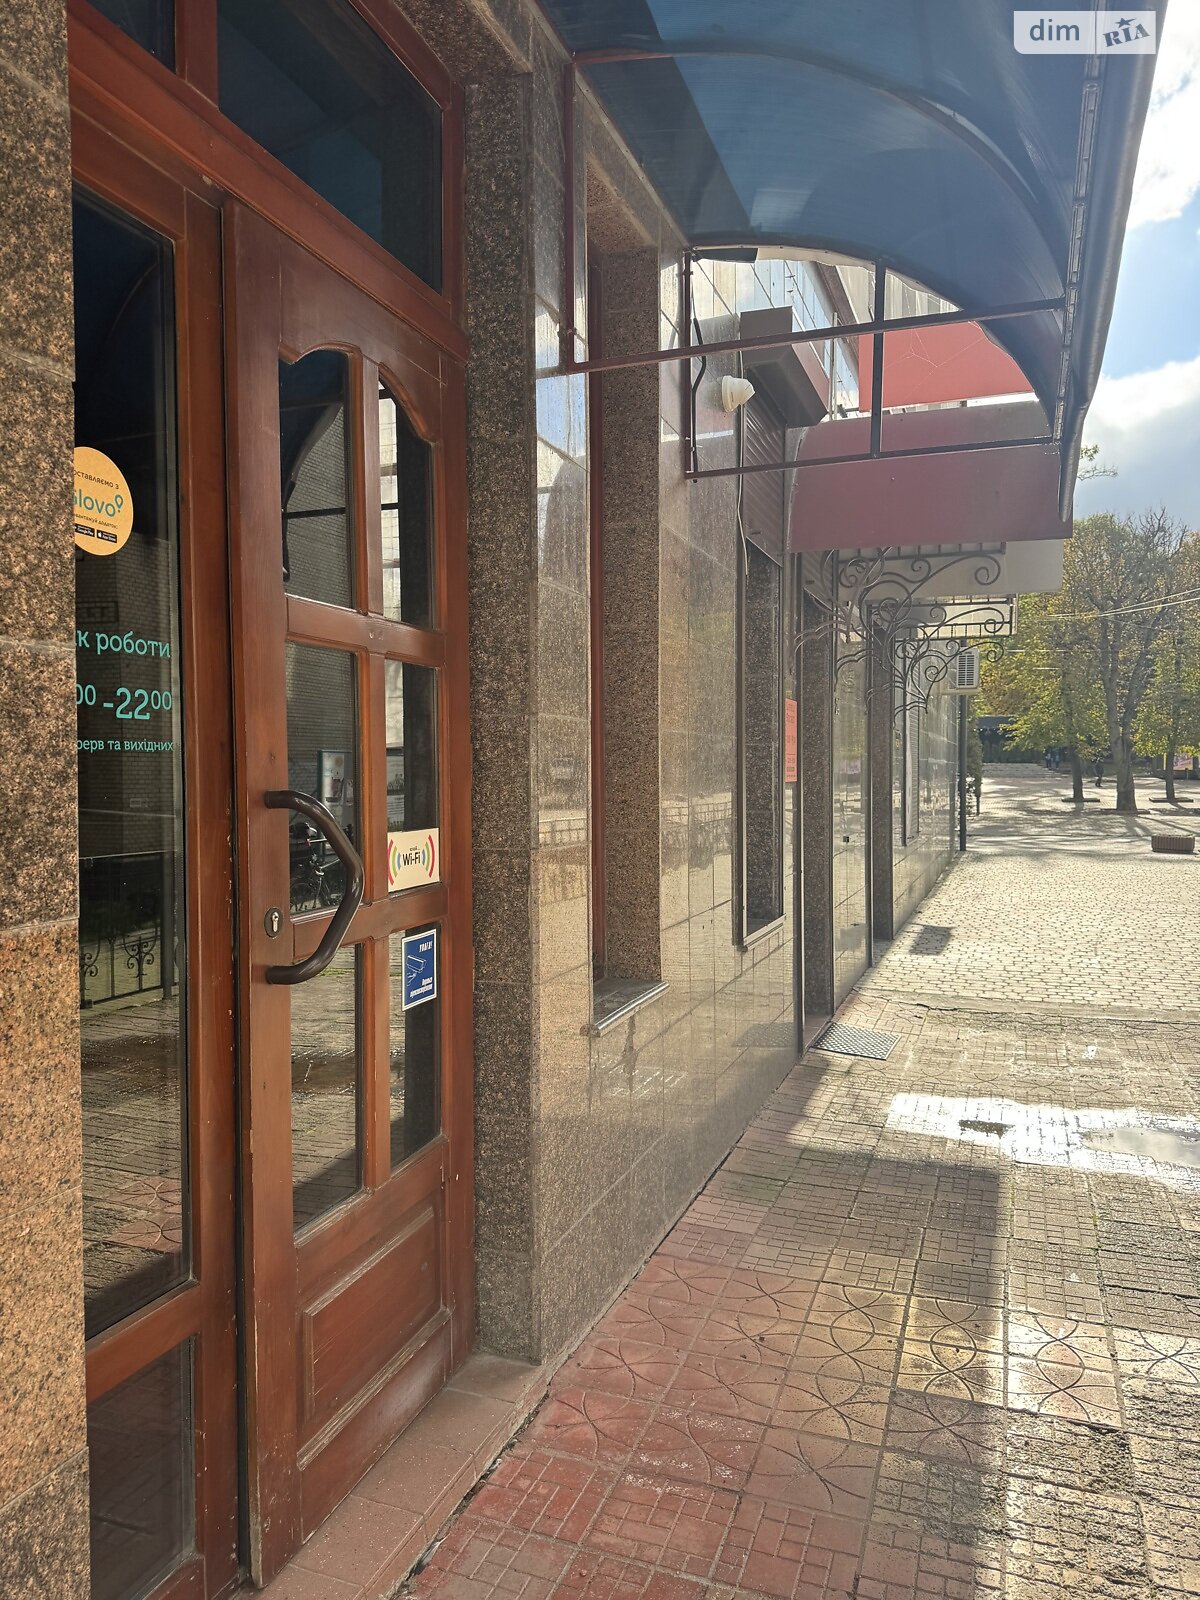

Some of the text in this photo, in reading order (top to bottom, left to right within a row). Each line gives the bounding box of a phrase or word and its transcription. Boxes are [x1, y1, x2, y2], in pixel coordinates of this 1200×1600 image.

[76, 630, 171, 658] к роботи
[107, 740, 122, 750] та
[124, 738, 174, 753] вихідних
[402, 851, 421, 866] Wi-Fi
